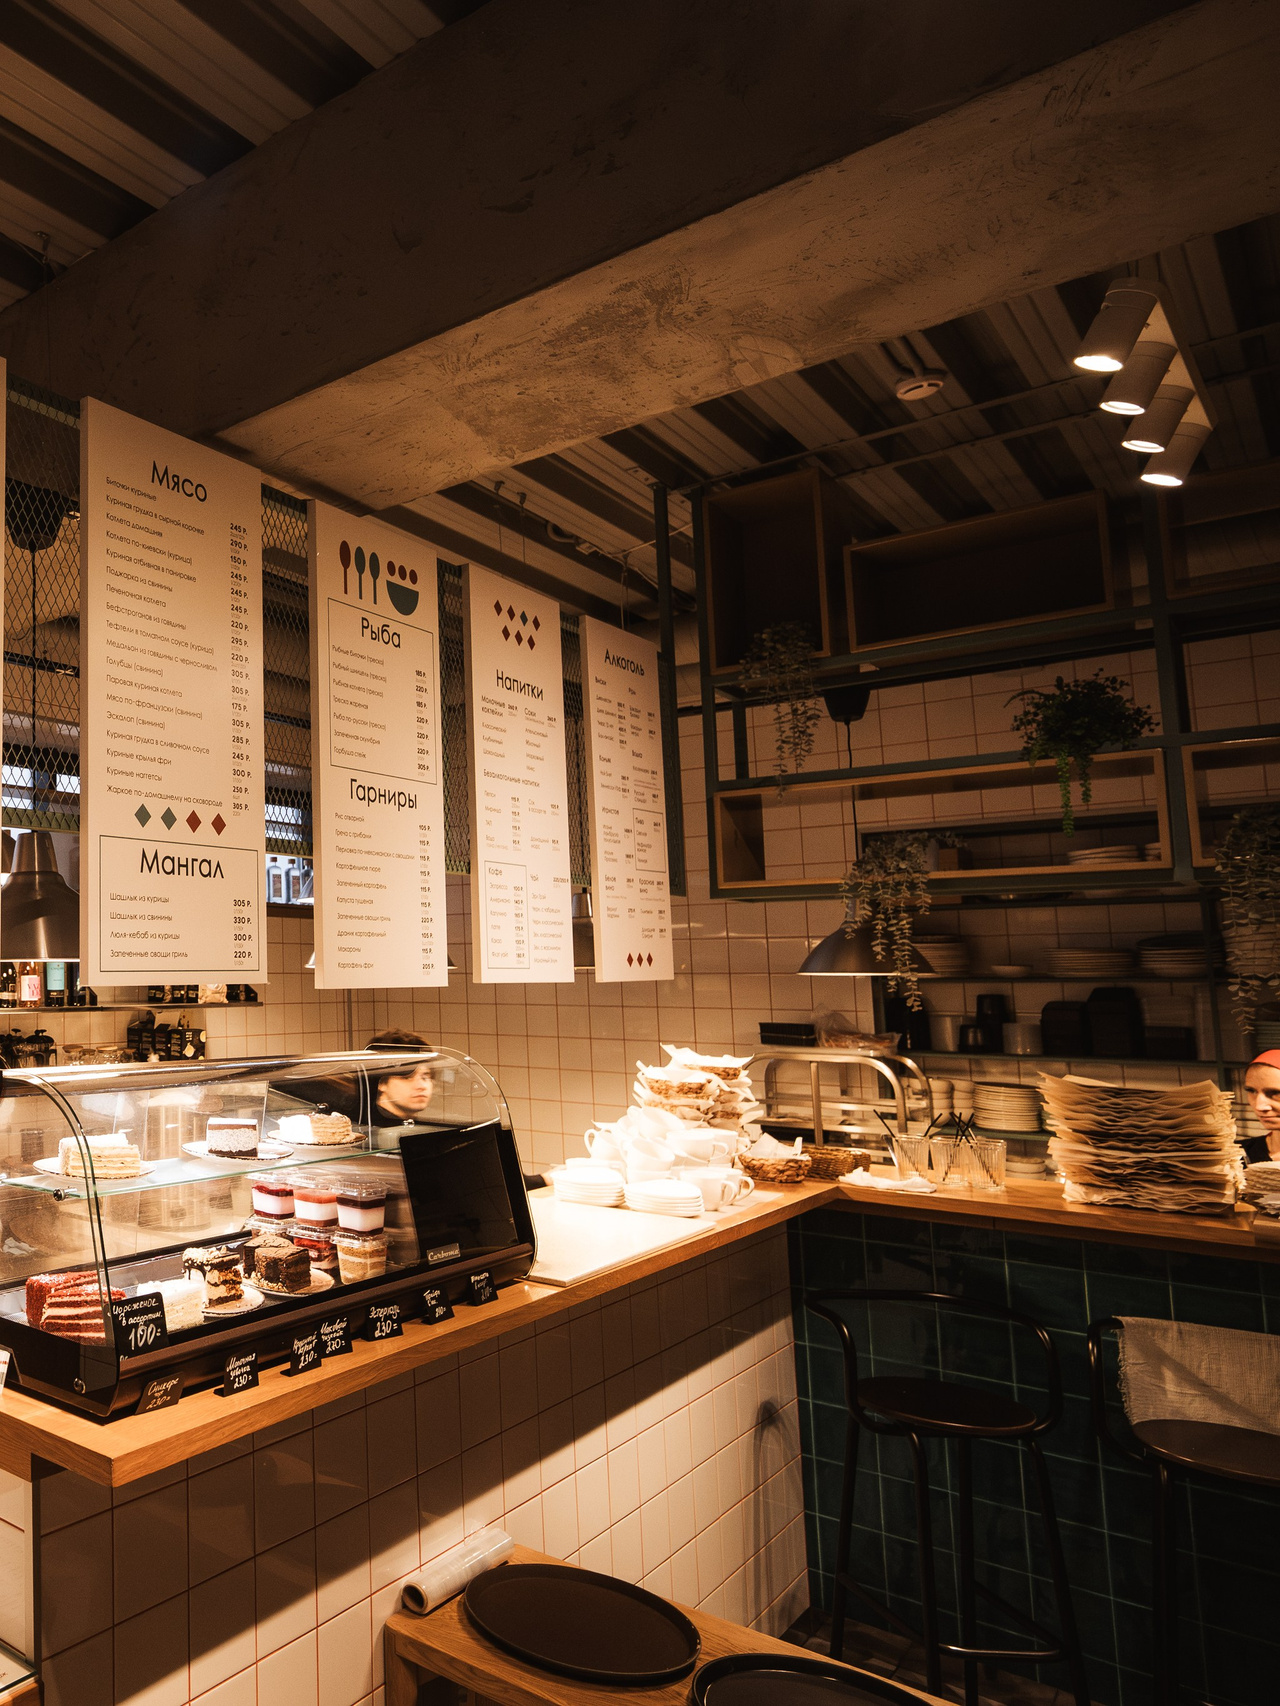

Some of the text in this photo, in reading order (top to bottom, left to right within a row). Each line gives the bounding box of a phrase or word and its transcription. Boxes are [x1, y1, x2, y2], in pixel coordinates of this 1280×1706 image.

[151, 460, 208, 503] Мясо
[105, 512, 163, 538] Котлета домашняя
[230, 603, 249, 616] 245 Р.
[361, 616, 401, 649] Рыба
[106, 655, 164, 678] Голубцы (свинина)
[604, 648, 645, 677] Алкоголь
[496, 669, 544, 701] Напитки
[524, 707, 537, 717] Соки
[350, 777, 417, 812] Гарниры
[140, 847, 225, 879] Мангал
[488, 867, 503, 876] Кофе
[109, 911, 138, 921] Шашлык
[146, 914, 173, 922] свинины
[233, 916, 252, 925] 330 Р.
